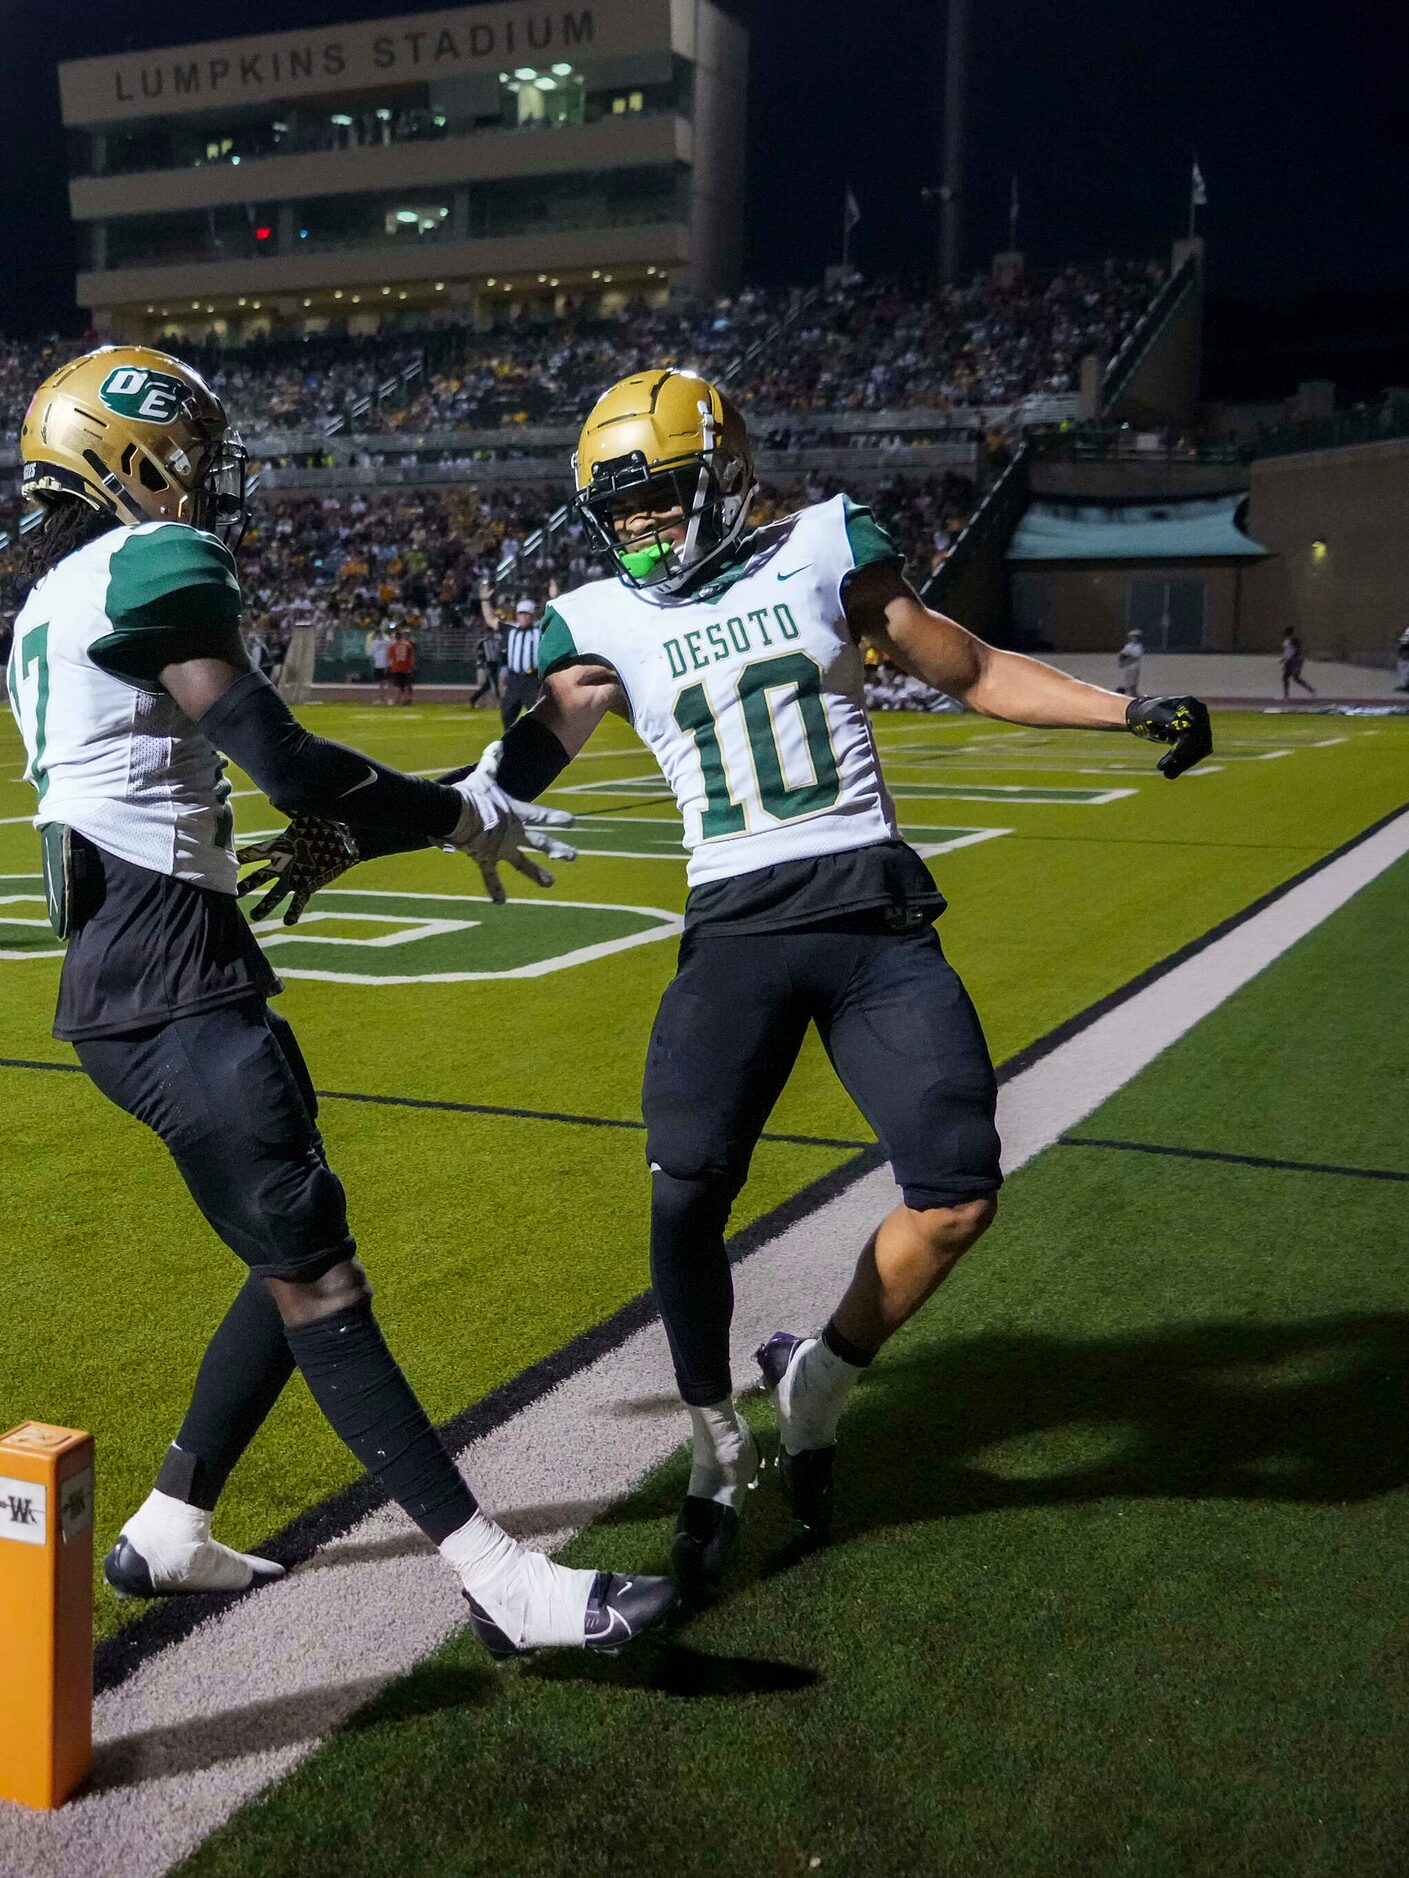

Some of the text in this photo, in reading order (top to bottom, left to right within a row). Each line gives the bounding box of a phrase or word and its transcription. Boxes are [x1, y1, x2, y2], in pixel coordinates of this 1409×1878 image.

[115, 10, 594, 101] LUMPKINS STADIUM
[662, 603, 800, 678] DESOTO
[672, 648, 844, 840] 10
